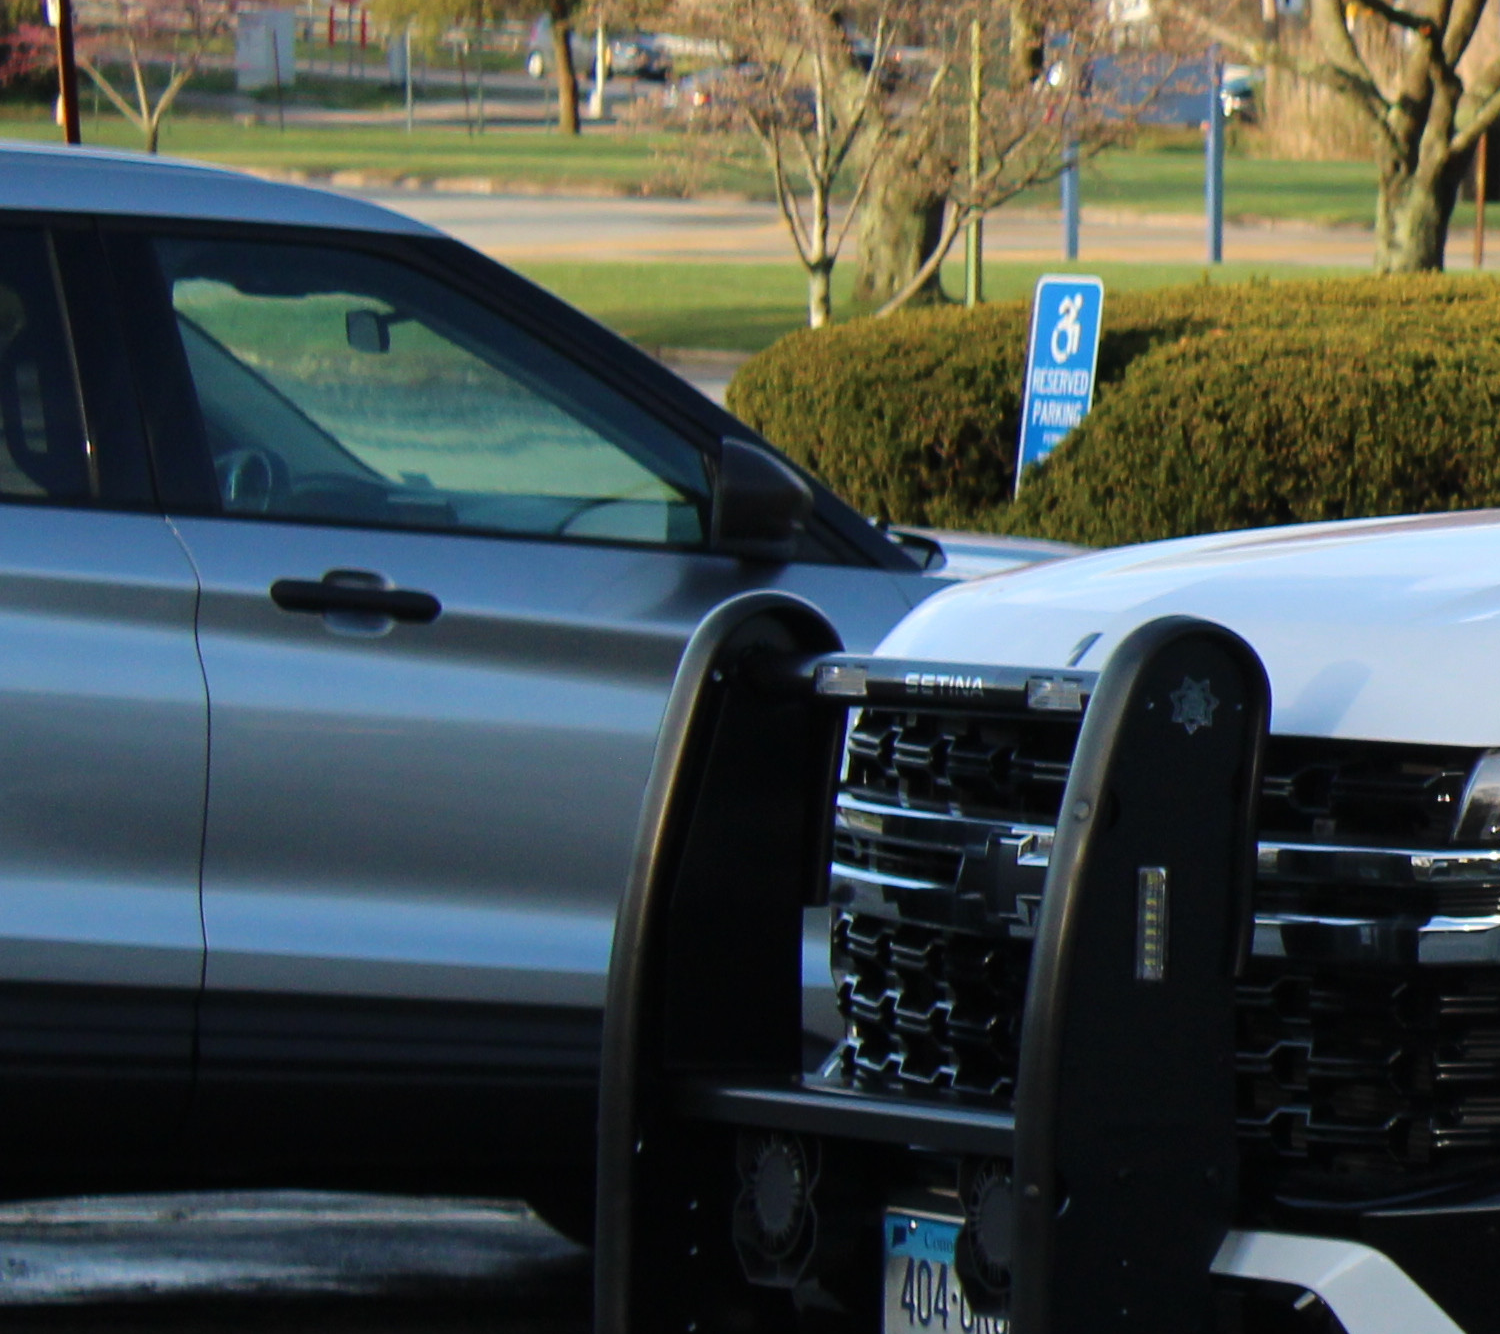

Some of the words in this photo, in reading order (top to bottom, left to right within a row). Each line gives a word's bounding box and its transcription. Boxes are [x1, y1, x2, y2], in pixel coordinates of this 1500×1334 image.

[1031, 368, 1089, 395] RESERVED
[1032, 400, 1081, 427] PARKING
[905, 672, 984, 696] SETINA
